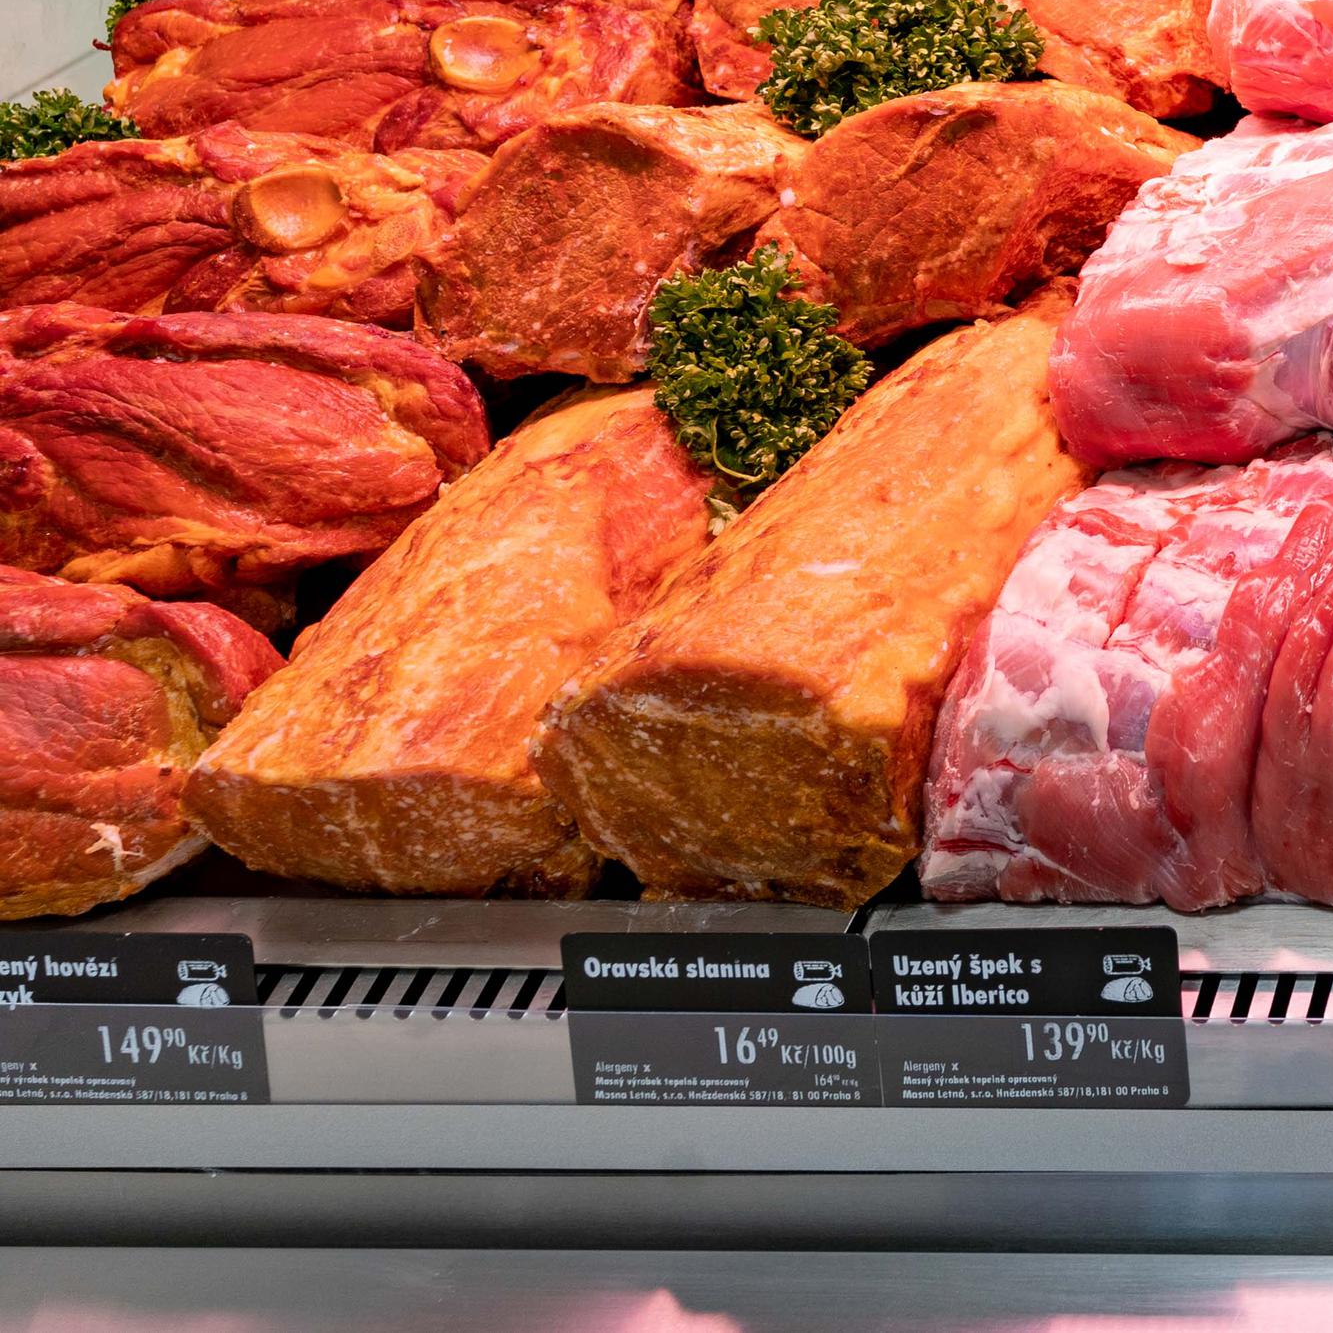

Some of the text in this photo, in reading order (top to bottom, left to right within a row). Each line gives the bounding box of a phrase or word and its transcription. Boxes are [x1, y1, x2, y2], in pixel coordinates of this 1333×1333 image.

[0, 955, 117, 981] ený hovězí
[584, 957, 770, 979] Oravská slanina
[893, 953, 1042, 979] Uzený špek s
[895, 985, 1030, 1006] kůží Iberico
[188, 1044, 242, 1069] Kč/Kg
[781, 1044, 857, 1069] Kč/100g
[1111, 1039, 1165, 1064] Kč/Kg
[30, 1062, 37, 1070] x
[595, 1061, 651, 1074] Alergeny x
[904, 1061, 958, 1073] Alergeny x
[904, 1075, 932, 1086] Masný
[935, 1075, 970, 1086] výrobek
[1008, 1074, 1057, 1085] opracovaný
[209, 1091, 238, 1100] Praha
[808, 1091, 820, 1100] 00
[823, 1091, 851, 1100] Praha
[854, 1091, 860, 1100] 8
[903, 1089, 934, 1099] Masna
[938, 1089, 968, 1099] Letná,
[971, 1090, 994, 1098] s.r.o.
[997, 1087, 1054, 1097] Hnězdenská
[1116, 1087, 1128, 1095] 00
[1131, 1086, 1160, 1095] Praha
[1162, 1085, 1169, 1095] 8
